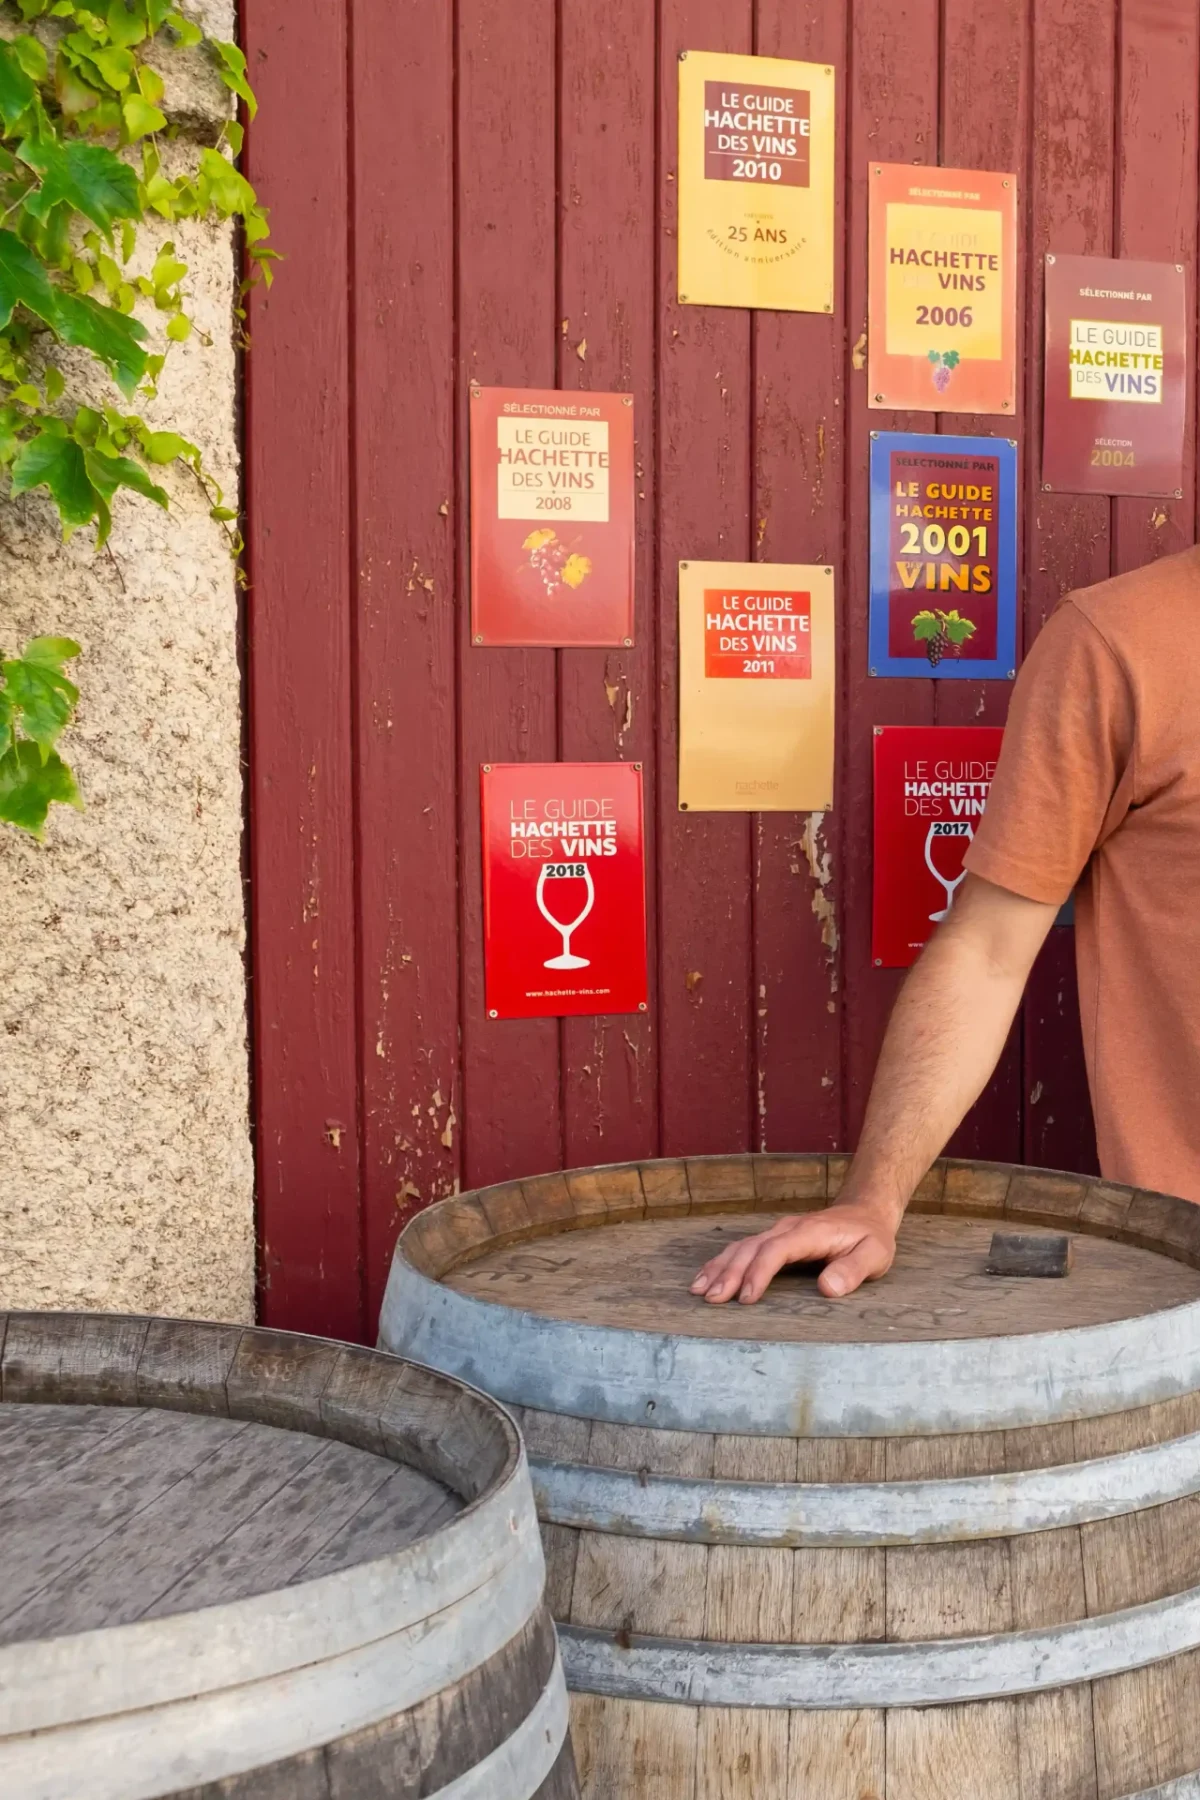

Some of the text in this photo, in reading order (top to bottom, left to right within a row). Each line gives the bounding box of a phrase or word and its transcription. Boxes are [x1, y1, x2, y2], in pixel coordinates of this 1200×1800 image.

[722, 93, 793, 114] LE GUIDE
[704, 110, 810, 136] HACHETTE
[718, 134, 796, 156] DES VINS
[733, 160, 781, 180] 2010
[728, 226, 787, 244] 25 ANS
[890, 248, 998, 271] HACHETTE
[938, 272, 985, 291] VINS
[1080, 287, 1152, 301] SÉLECTIONNÉ PAR
[916, 306, 972, 327] 2006
[1077, 327, 1156, 347] LE GUIDE
[1070, 349, 1162, 370] HACHETTE
[1077, 371, 1156, 395] DES VINS
[503, 402, 600, 416] SÉLECTIONNÉ PAR
[515, 430, 591, 446] LE GUIDE
[498, 448, 609, 468] HACHETTE
[973, 462, 994, 471] PAR
[1091, 450, 1135, 467] 2004
[512, 471, 594, 489] DES VINS
[896, 482, 992, 501] LE GUIDE
[536, 497, 572, 510] 2008
[896, 504, 992, 521] HACHETTE
[900, 523, 987, 557] 2001
[896, 561, 991, 592] VINS
[723, 596, 792, 611] LE GUIDE
[706, 614, 809, 632] HACHETTE
[720, 635, 797, 652] DES VINS
[743, 660, 774, 672] 2011
[904, 761, 997, 779] LE GUIDE
[905, 782, 991, 796] HACHETT
[510, 799, 614, 819] LE GUIDE
[905, 799, 985, 816] DES VIN
[511, 821, 617, 837] HACHETTE
[934, 823, 968, 834] 2017
[511, 838, 617, 858] DES VINS
[546, 864, 585, 877] 2018
[526, 988, 610, 997] www.hachette-vins.com
